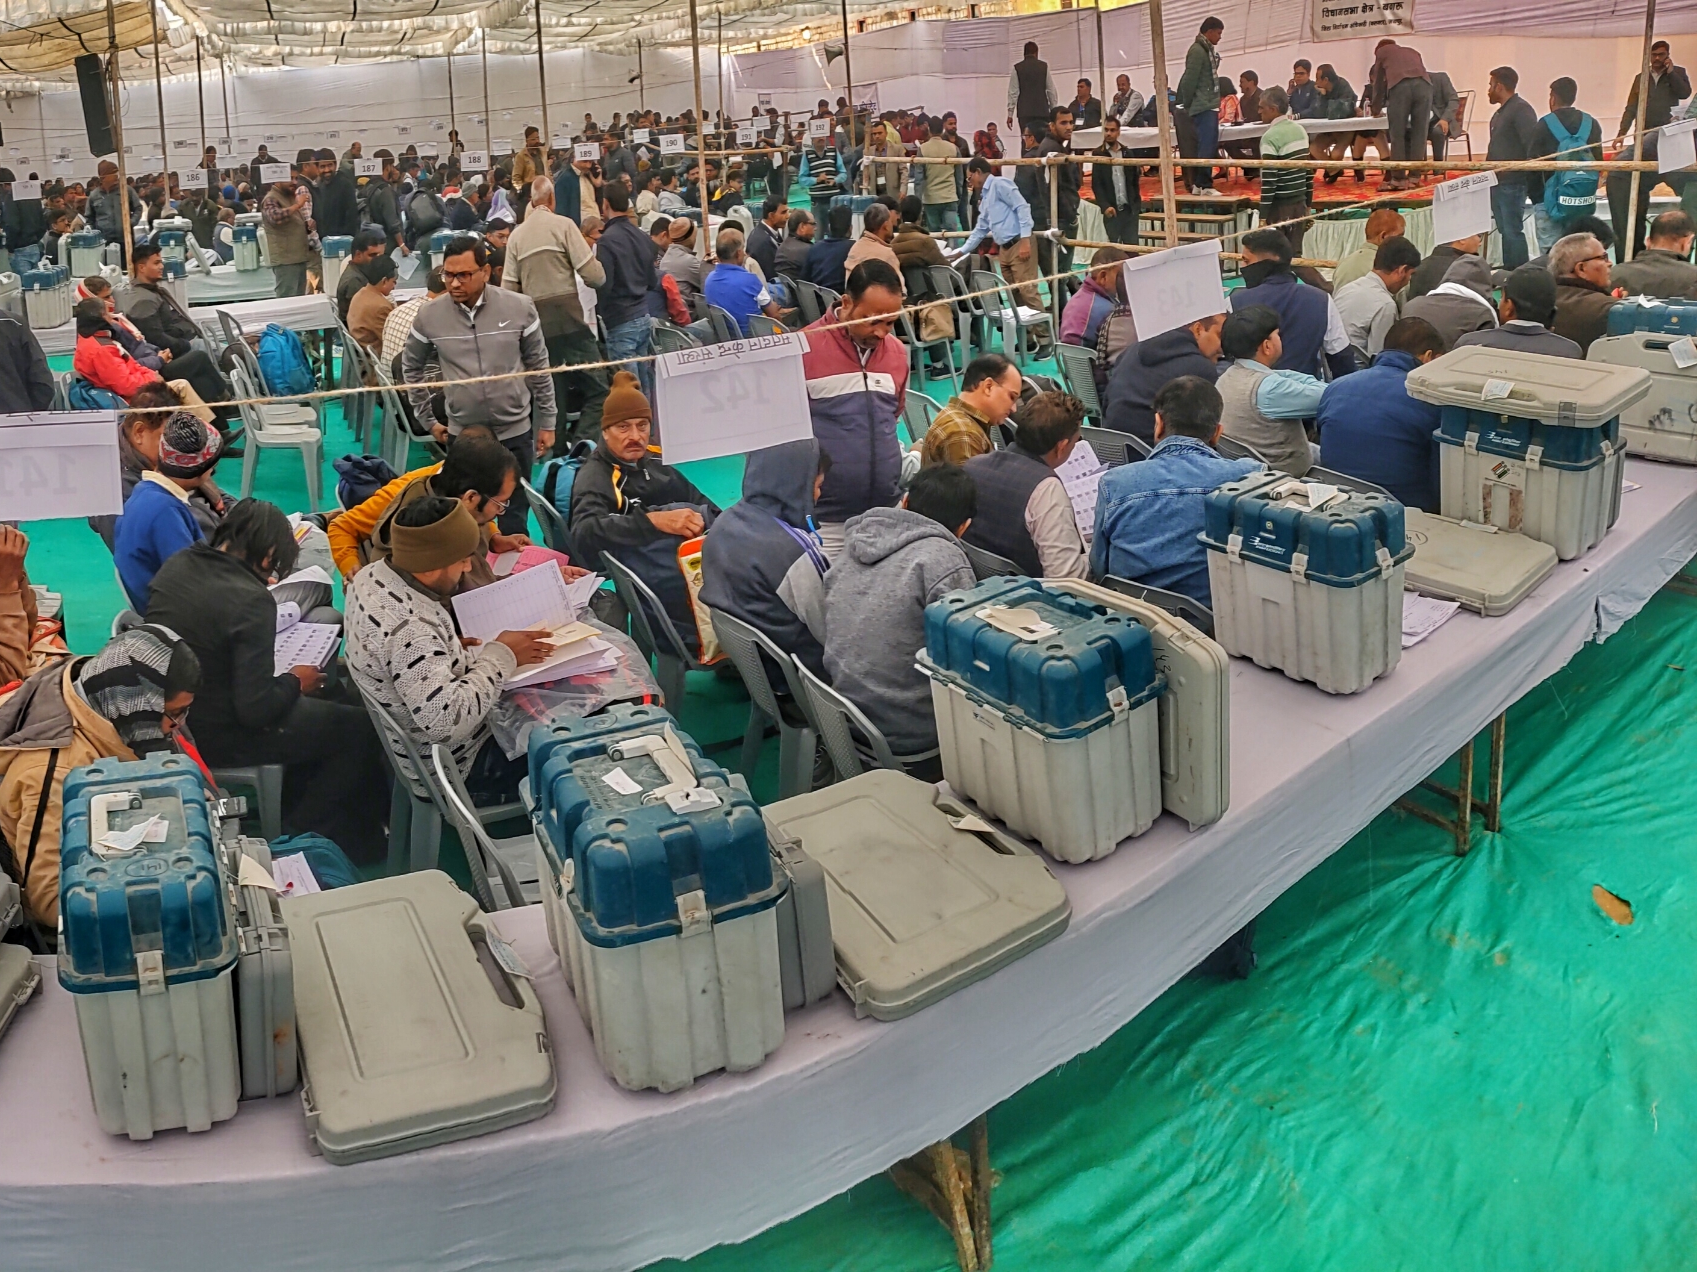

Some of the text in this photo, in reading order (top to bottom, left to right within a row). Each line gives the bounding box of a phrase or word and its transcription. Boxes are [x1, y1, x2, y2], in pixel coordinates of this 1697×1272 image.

[665, 139, 678, 147] 190
[579, 150, 592, 158] 189
[468, 155, 482, 164] 188
[362, 164, 376, 173] 187
[186, 173, 200, 182] 186
[1562, 196, 1596, 205] HOTSHO
